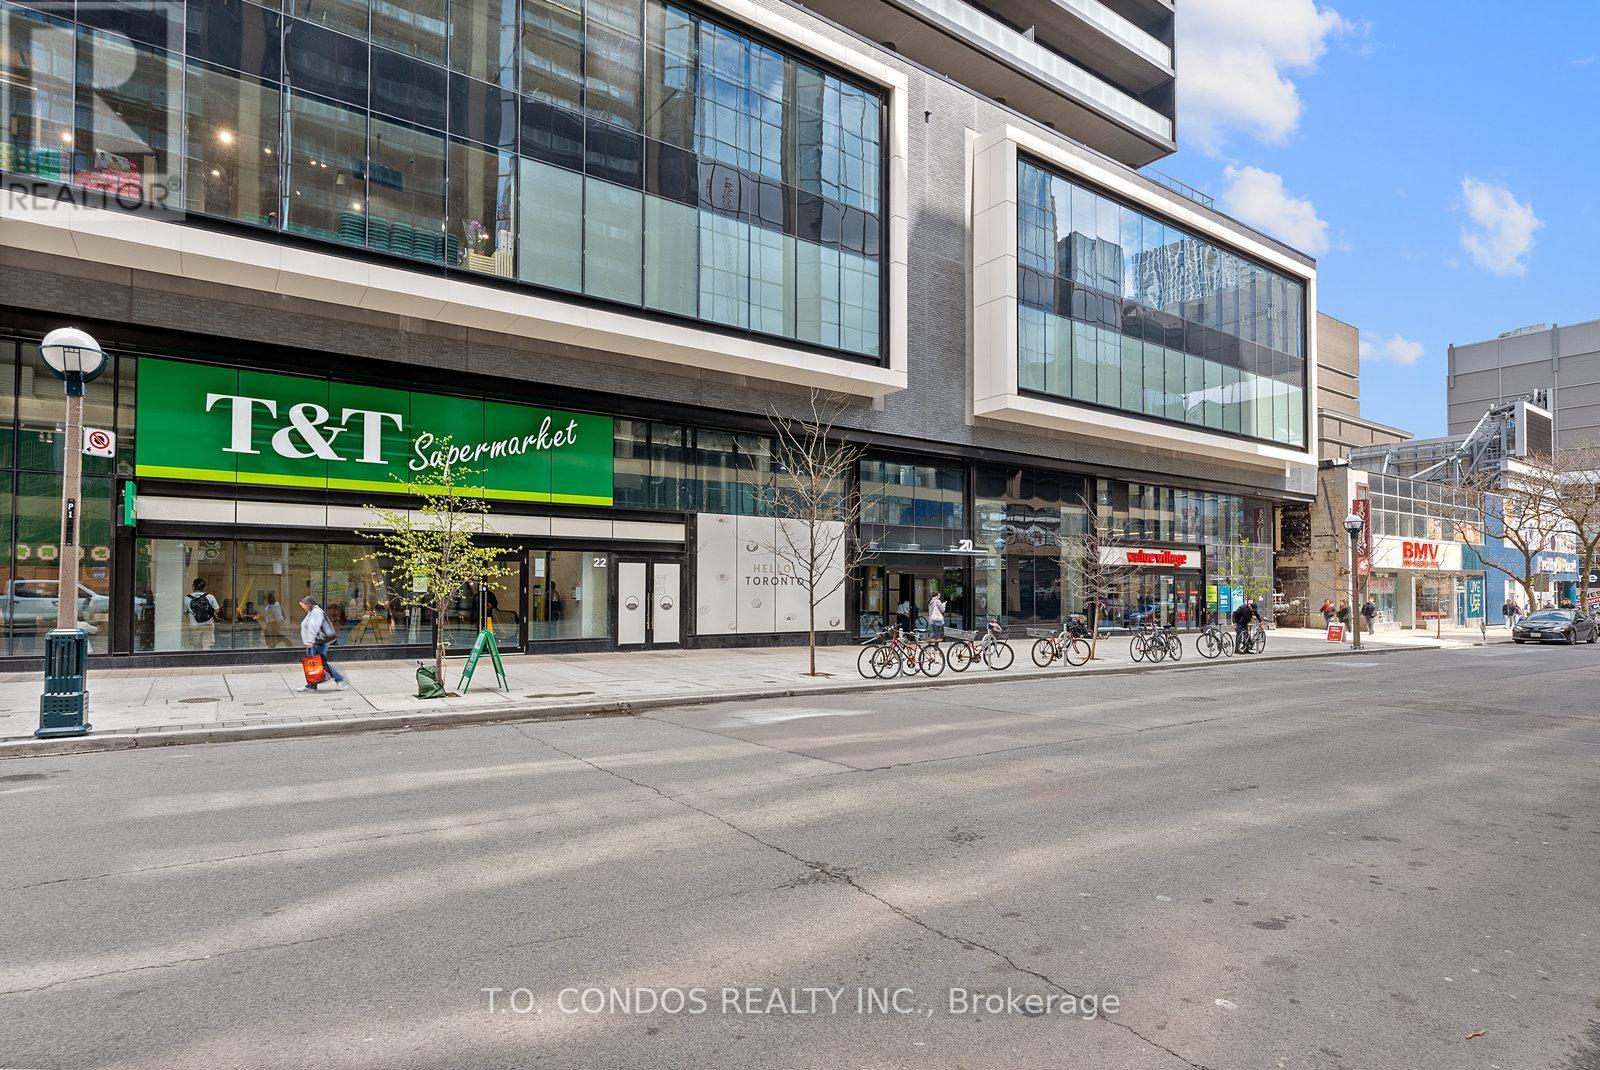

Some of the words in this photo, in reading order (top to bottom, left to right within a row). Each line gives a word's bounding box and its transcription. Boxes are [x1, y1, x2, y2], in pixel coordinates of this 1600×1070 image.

[205, 392, 404, 465] T&T
[408, 415, 578, 478] Supermarket
[959, 539, 973, 551] 20
[1402, 541, 1439, 560] BMV
[593, 557, 607, 568] 22
[753, 564, 791, 573] HELLO
[745, 576, 804, 586] TORONTO
